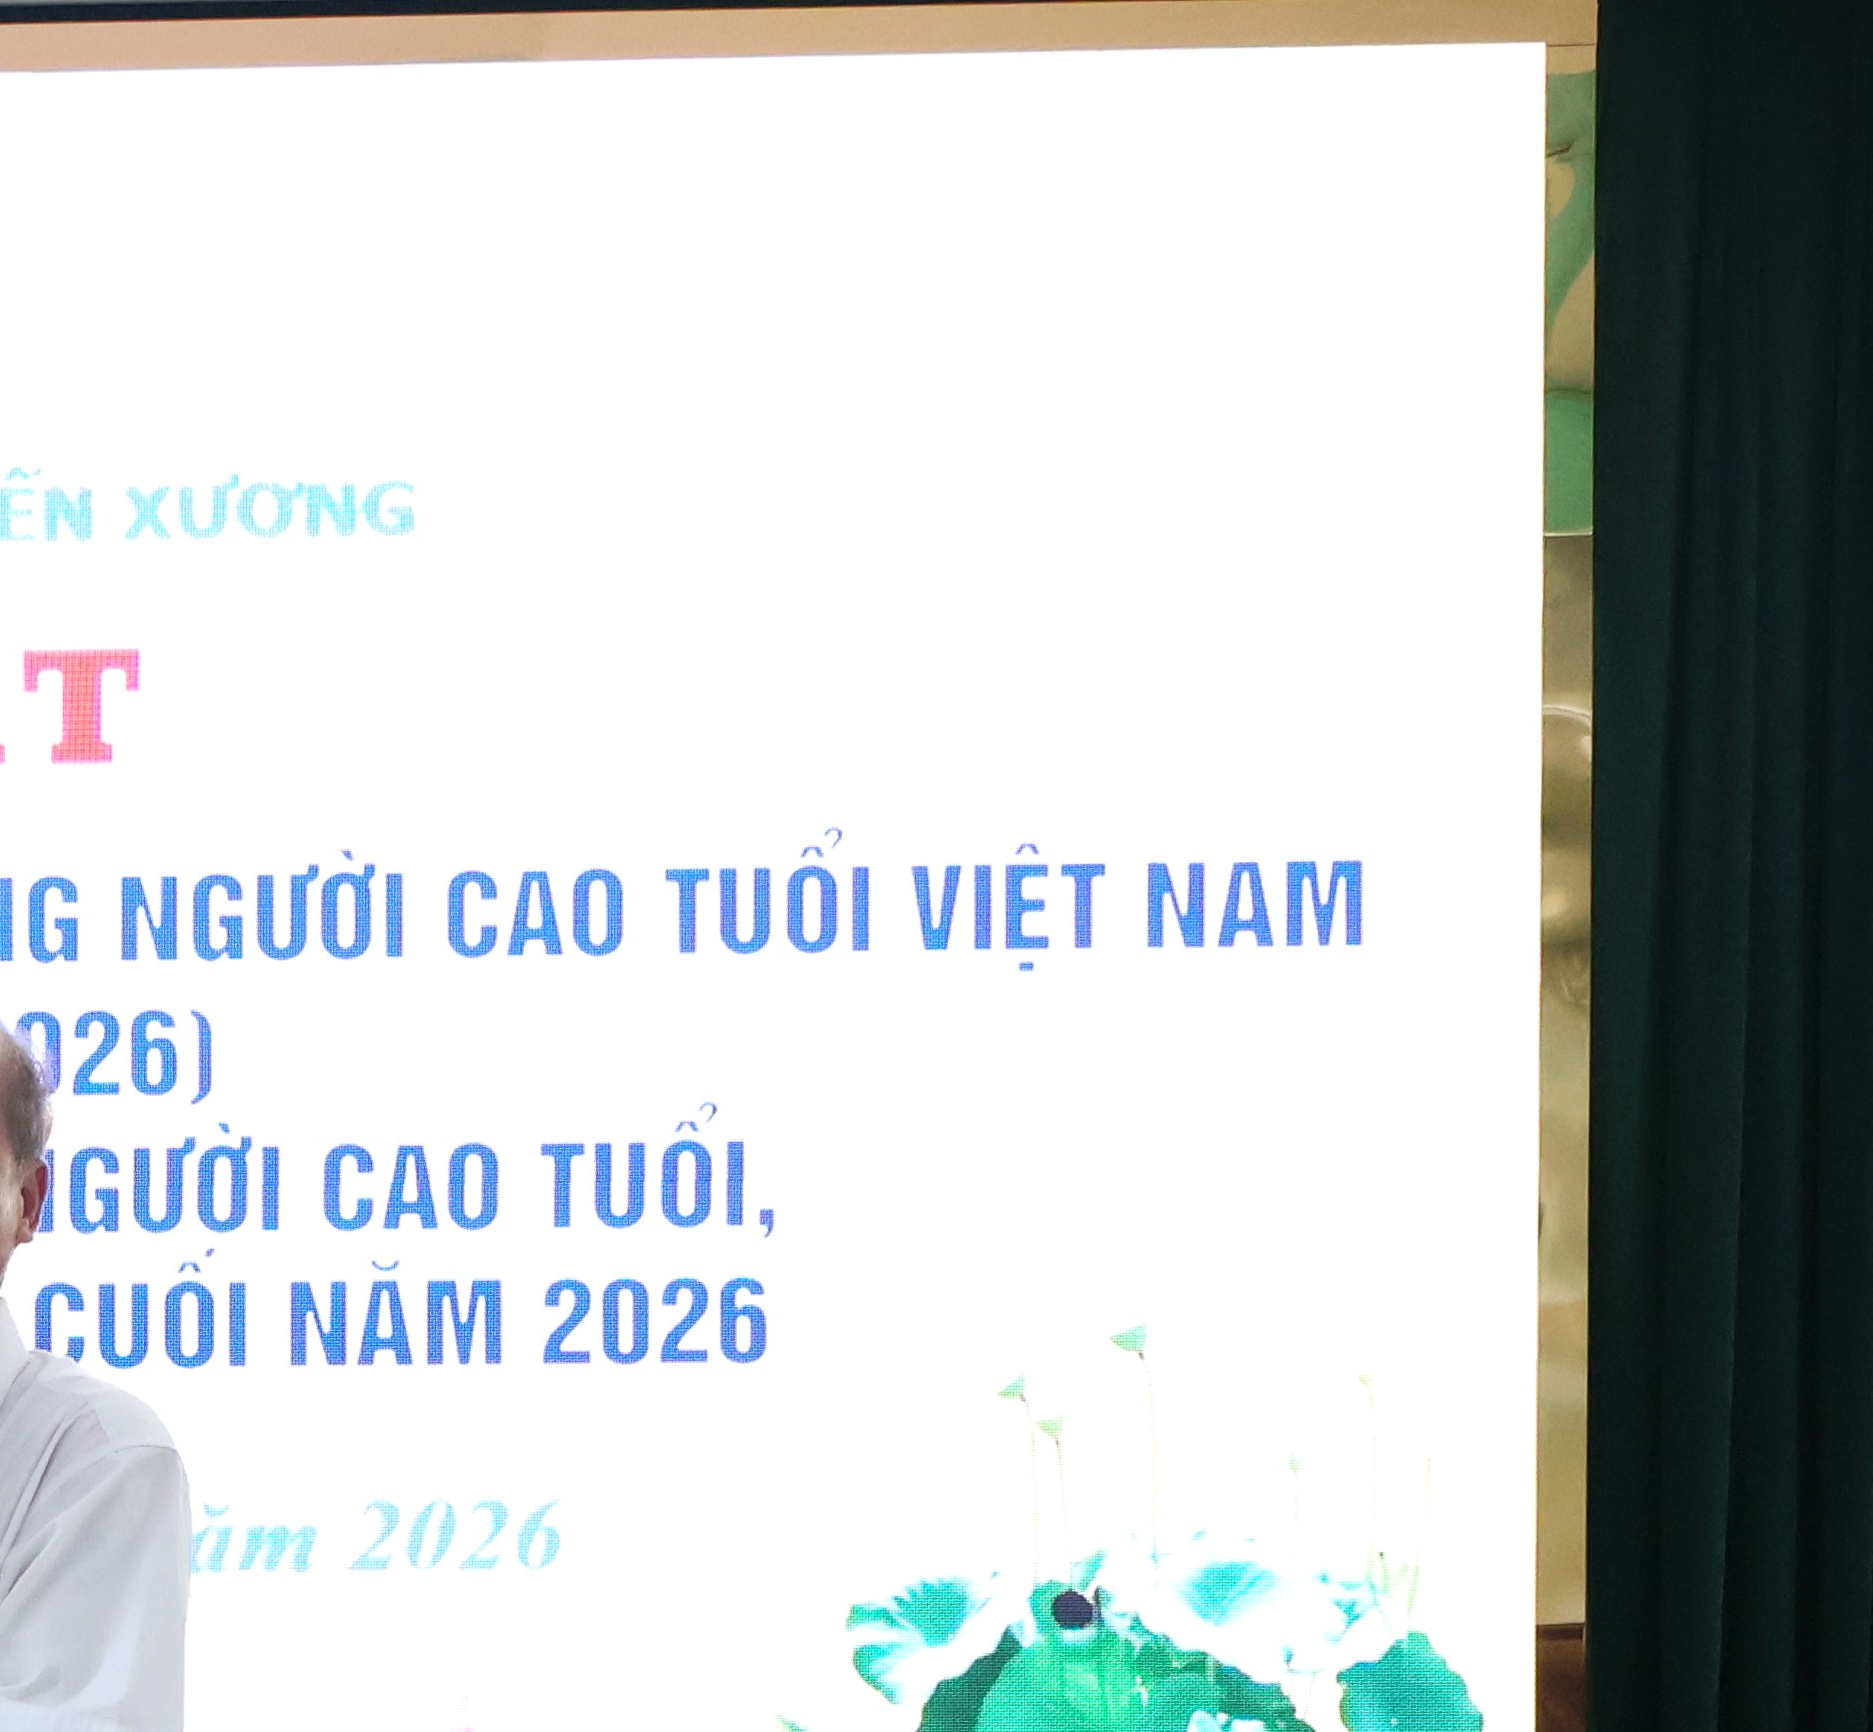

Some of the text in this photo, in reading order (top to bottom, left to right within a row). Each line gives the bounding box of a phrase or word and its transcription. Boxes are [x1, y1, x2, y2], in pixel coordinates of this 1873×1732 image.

[125, 474, 416, 540] XƯƠNG
[120, 850, 404, 962] NGƯỜI
[447, 868, 624, 959] CAO
[665, 828, 870, 954] TUỔI
[911, 843, 1107, 972] VIỆT
[1147, 860, 1363, 949] NAM
[323, 1142, 500, 1231] CAO
[540, 1102, 775, 1238] TUỔI,
[34, 1248, 247, 1370] CUỐI
[290, 1261, 503, 1366] NĂM
[542, 1277, 768, 1364] 2026
[191, 1499, 563, 1574] ăm 2026
